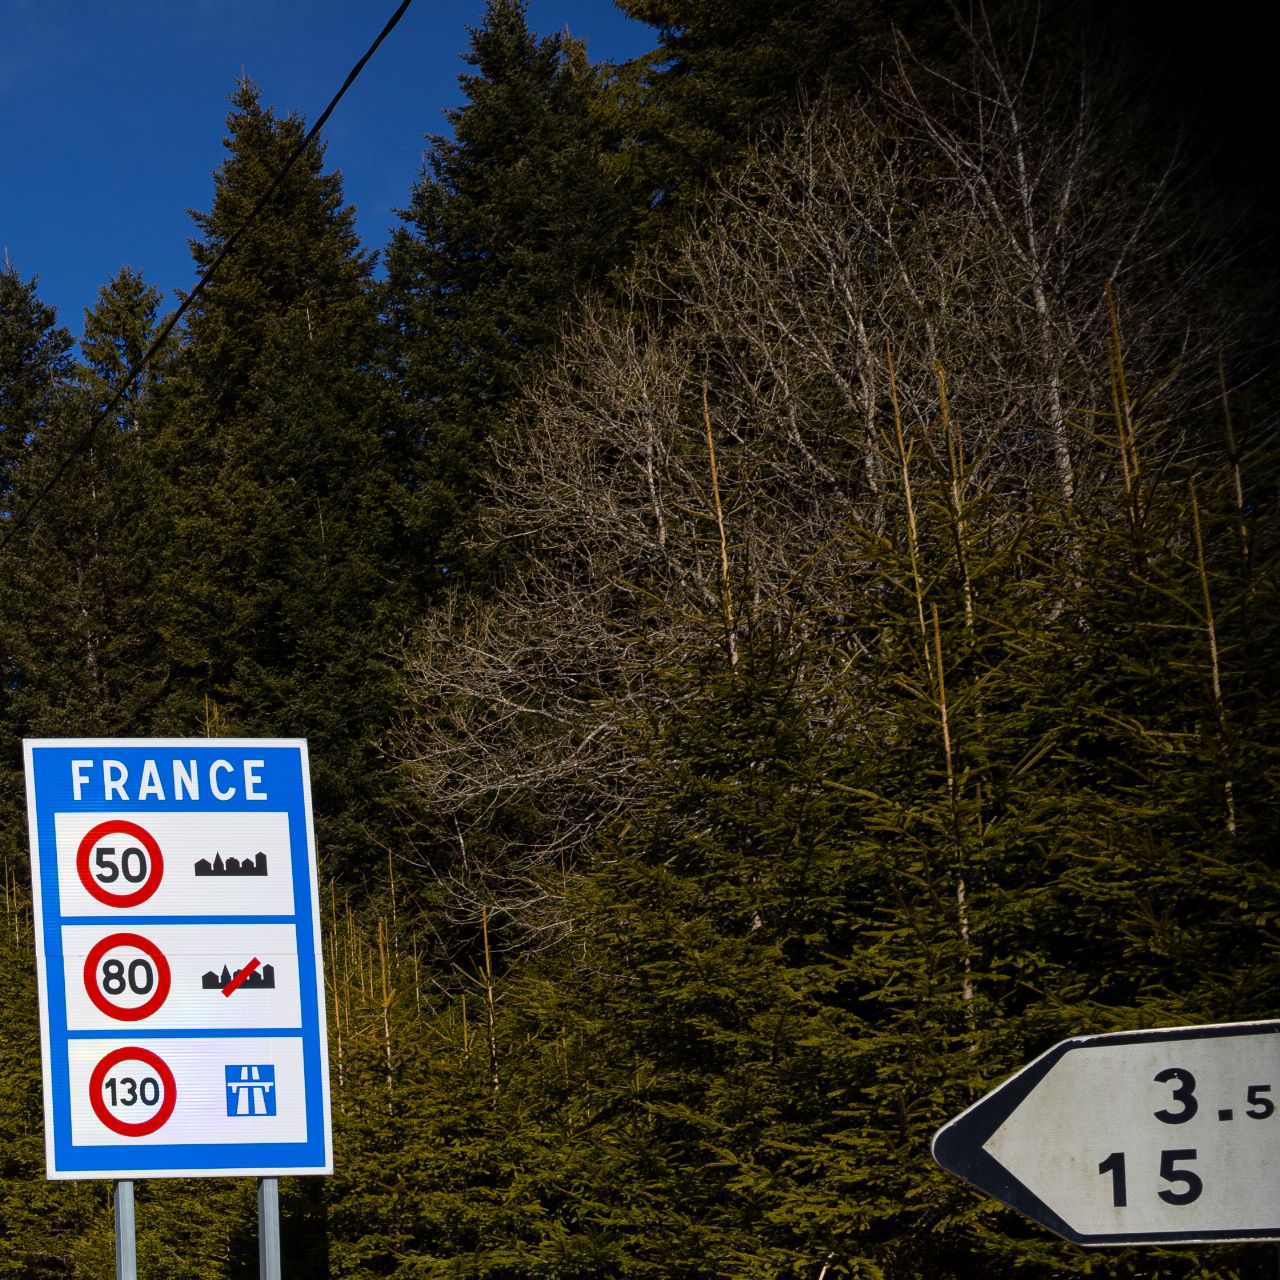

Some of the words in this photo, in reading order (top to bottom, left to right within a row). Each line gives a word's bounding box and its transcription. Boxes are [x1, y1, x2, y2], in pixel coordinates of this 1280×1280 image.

[71, 759, 269, 801] FRANCE
[95, 847, 147, 883] 50
[102, 958, 154, 995] 80
[104, 1076, 160, 1107] 130
[1153, 1067, 1275, 1125] 3.5
[1098, 1149, 1203, 1207] 15
